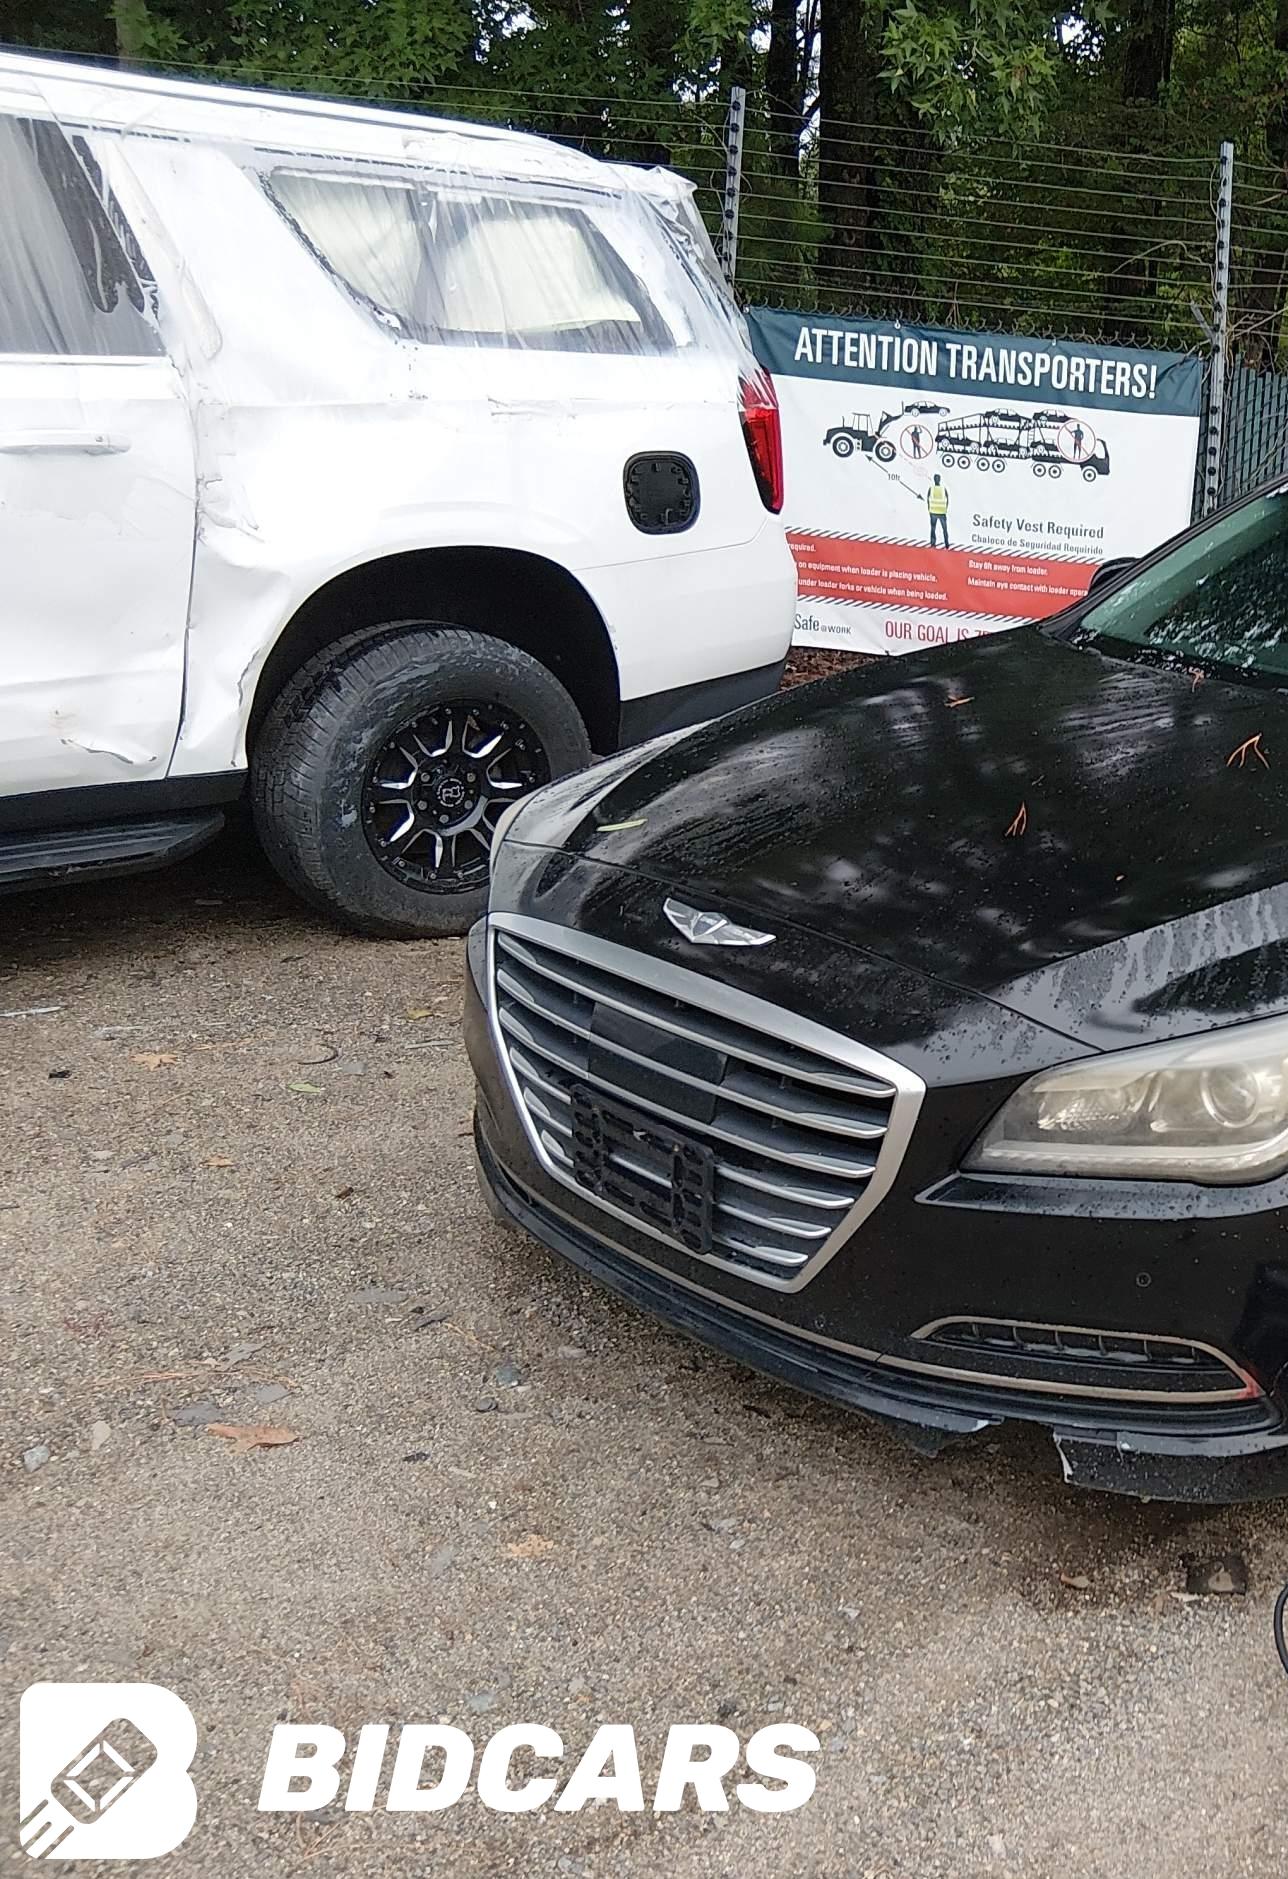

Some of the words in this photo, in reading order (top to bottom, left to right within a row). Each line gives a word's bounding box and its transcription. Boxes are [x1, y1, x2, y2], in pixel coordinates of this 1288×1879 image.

[795, 327, 937, 376] ATTENTION
[946, 343, 1157, 399] TRANSPORTERS!
[972, 513, 1012, 533] Safety
[1016, 518, 1043, 533] Vest
[1047, 521, 1104, 539] Required
[971, 534, 1005, 546] Chaleco
[1007, 538, 1017, 546] de
[1020, 538, 1061, 552] Seguridad
[808, 562, 840, 573] equipment
[841, 565, 860, 574] when
[861, 567, 880, 576] loader
[882, 569, 888, 577] is
[889, 570, 912, 581] placing
[968, 560, 983, 570] Stay
[1012, 564, 1026, 573] from
[818, 580, 838, 588] loader
[968, 576, 996, 588] Maintain
[1010, 582, 1033, 592] contact
[1034, 583, 1048, 593] with
[885, 620, 912, 640] OUR
